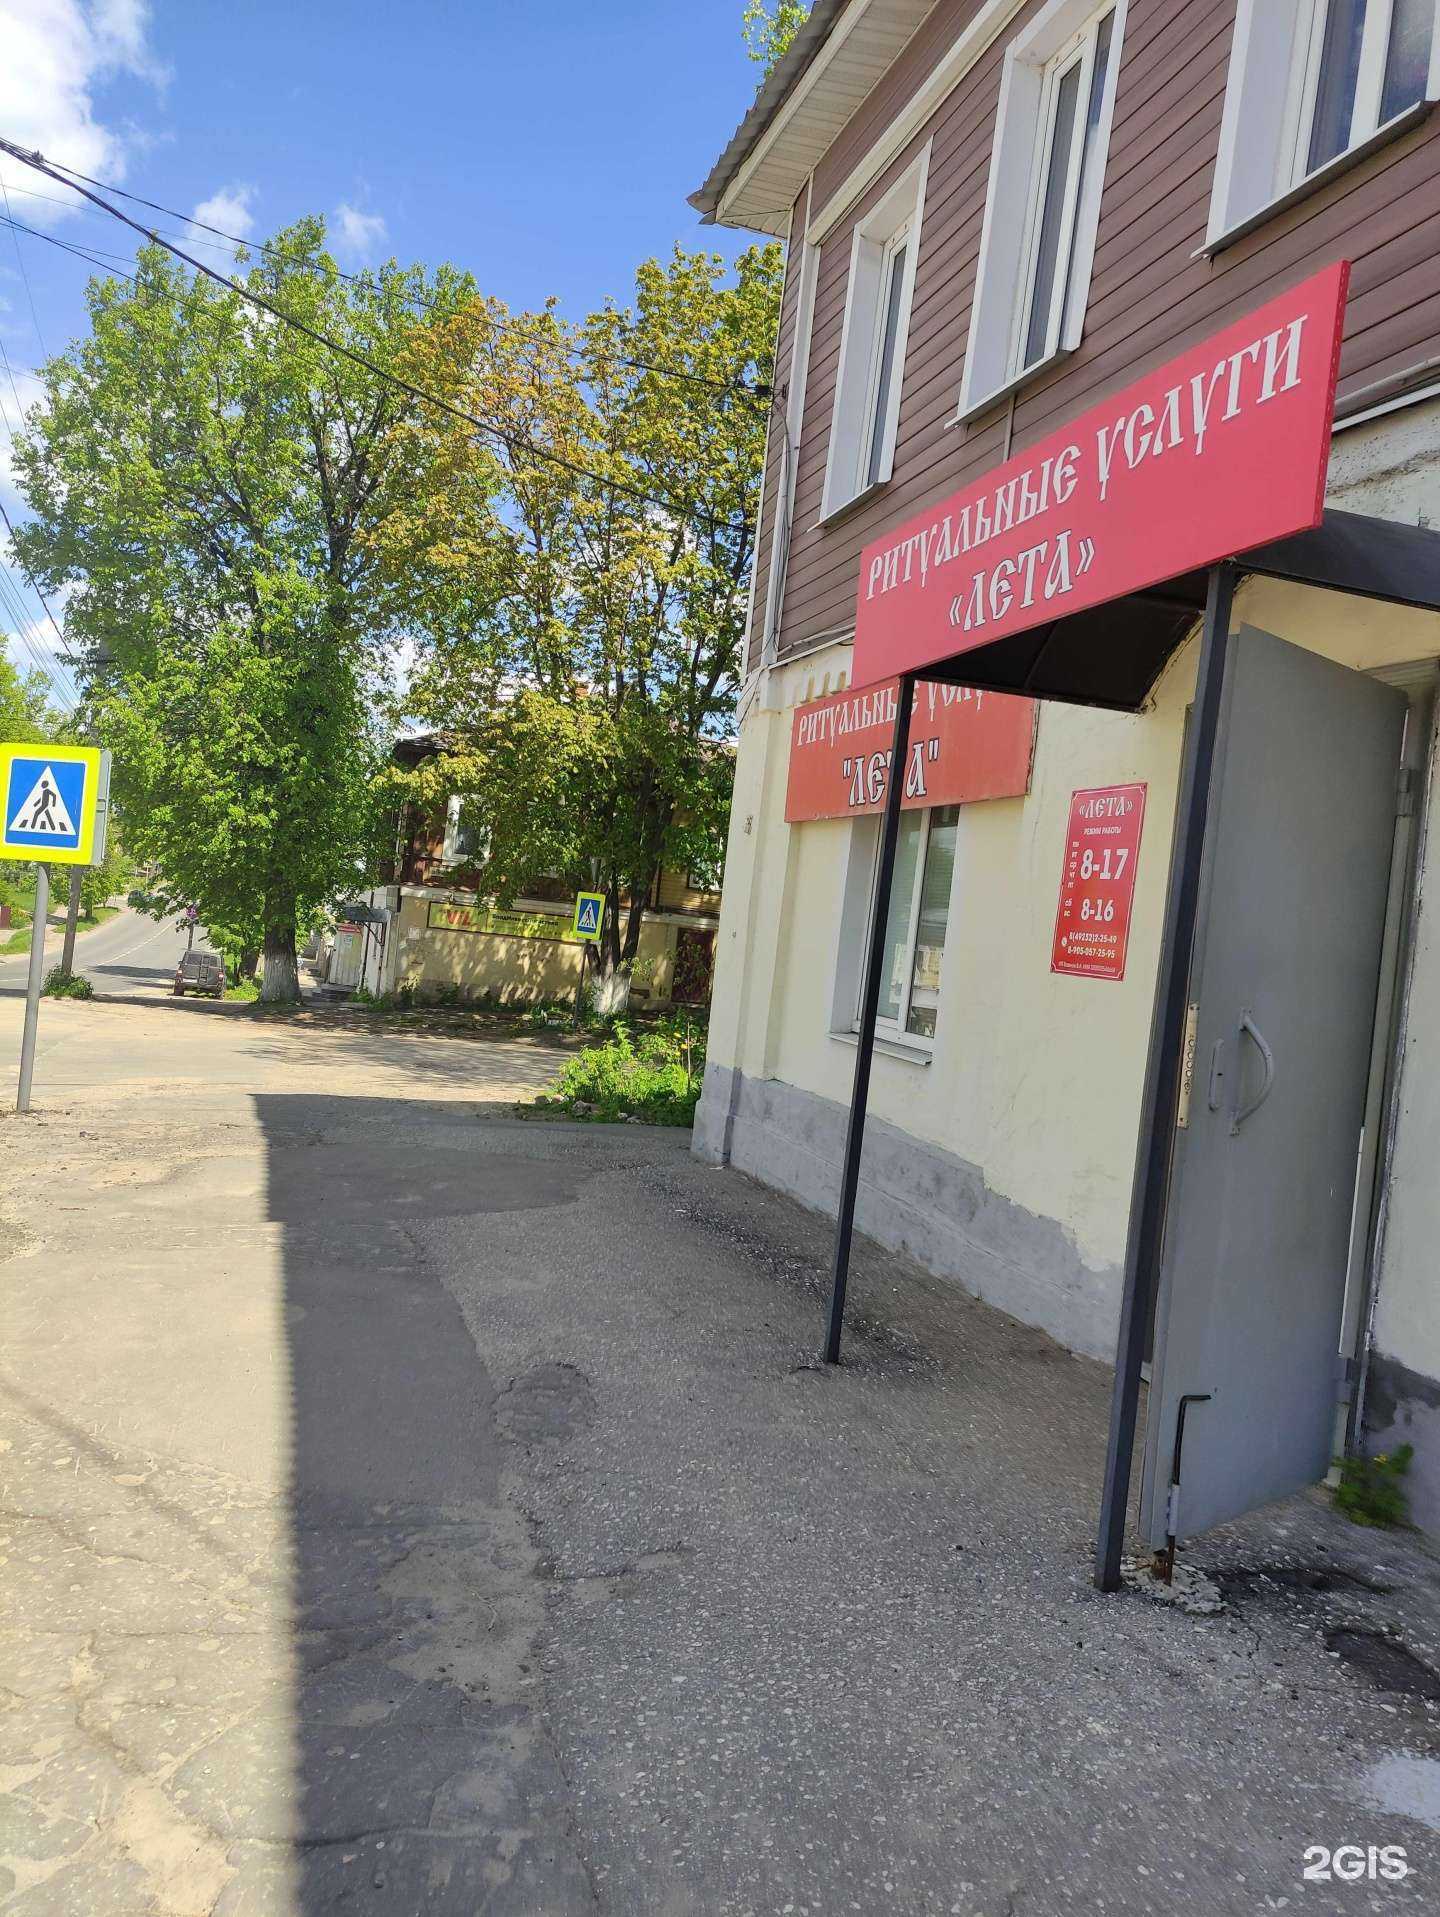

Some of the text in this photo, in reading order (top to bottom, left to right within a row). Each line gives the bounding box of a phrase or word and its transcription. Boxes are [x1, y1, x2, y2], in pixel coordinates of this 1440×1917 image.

[867, 315, 1308, 600] РИТУАЛЬНЫЕ УСЛУГИ
[949, 530, 1095, 631] «ЛЕТА»
[843, 737, 940, 807] "ЛЕА"
[1079, 796, 1133, 819] «ЛЕТА»
[1080, 848, 1129, 880] 8-17
[1080, 899, 1114, 921] 8-16
